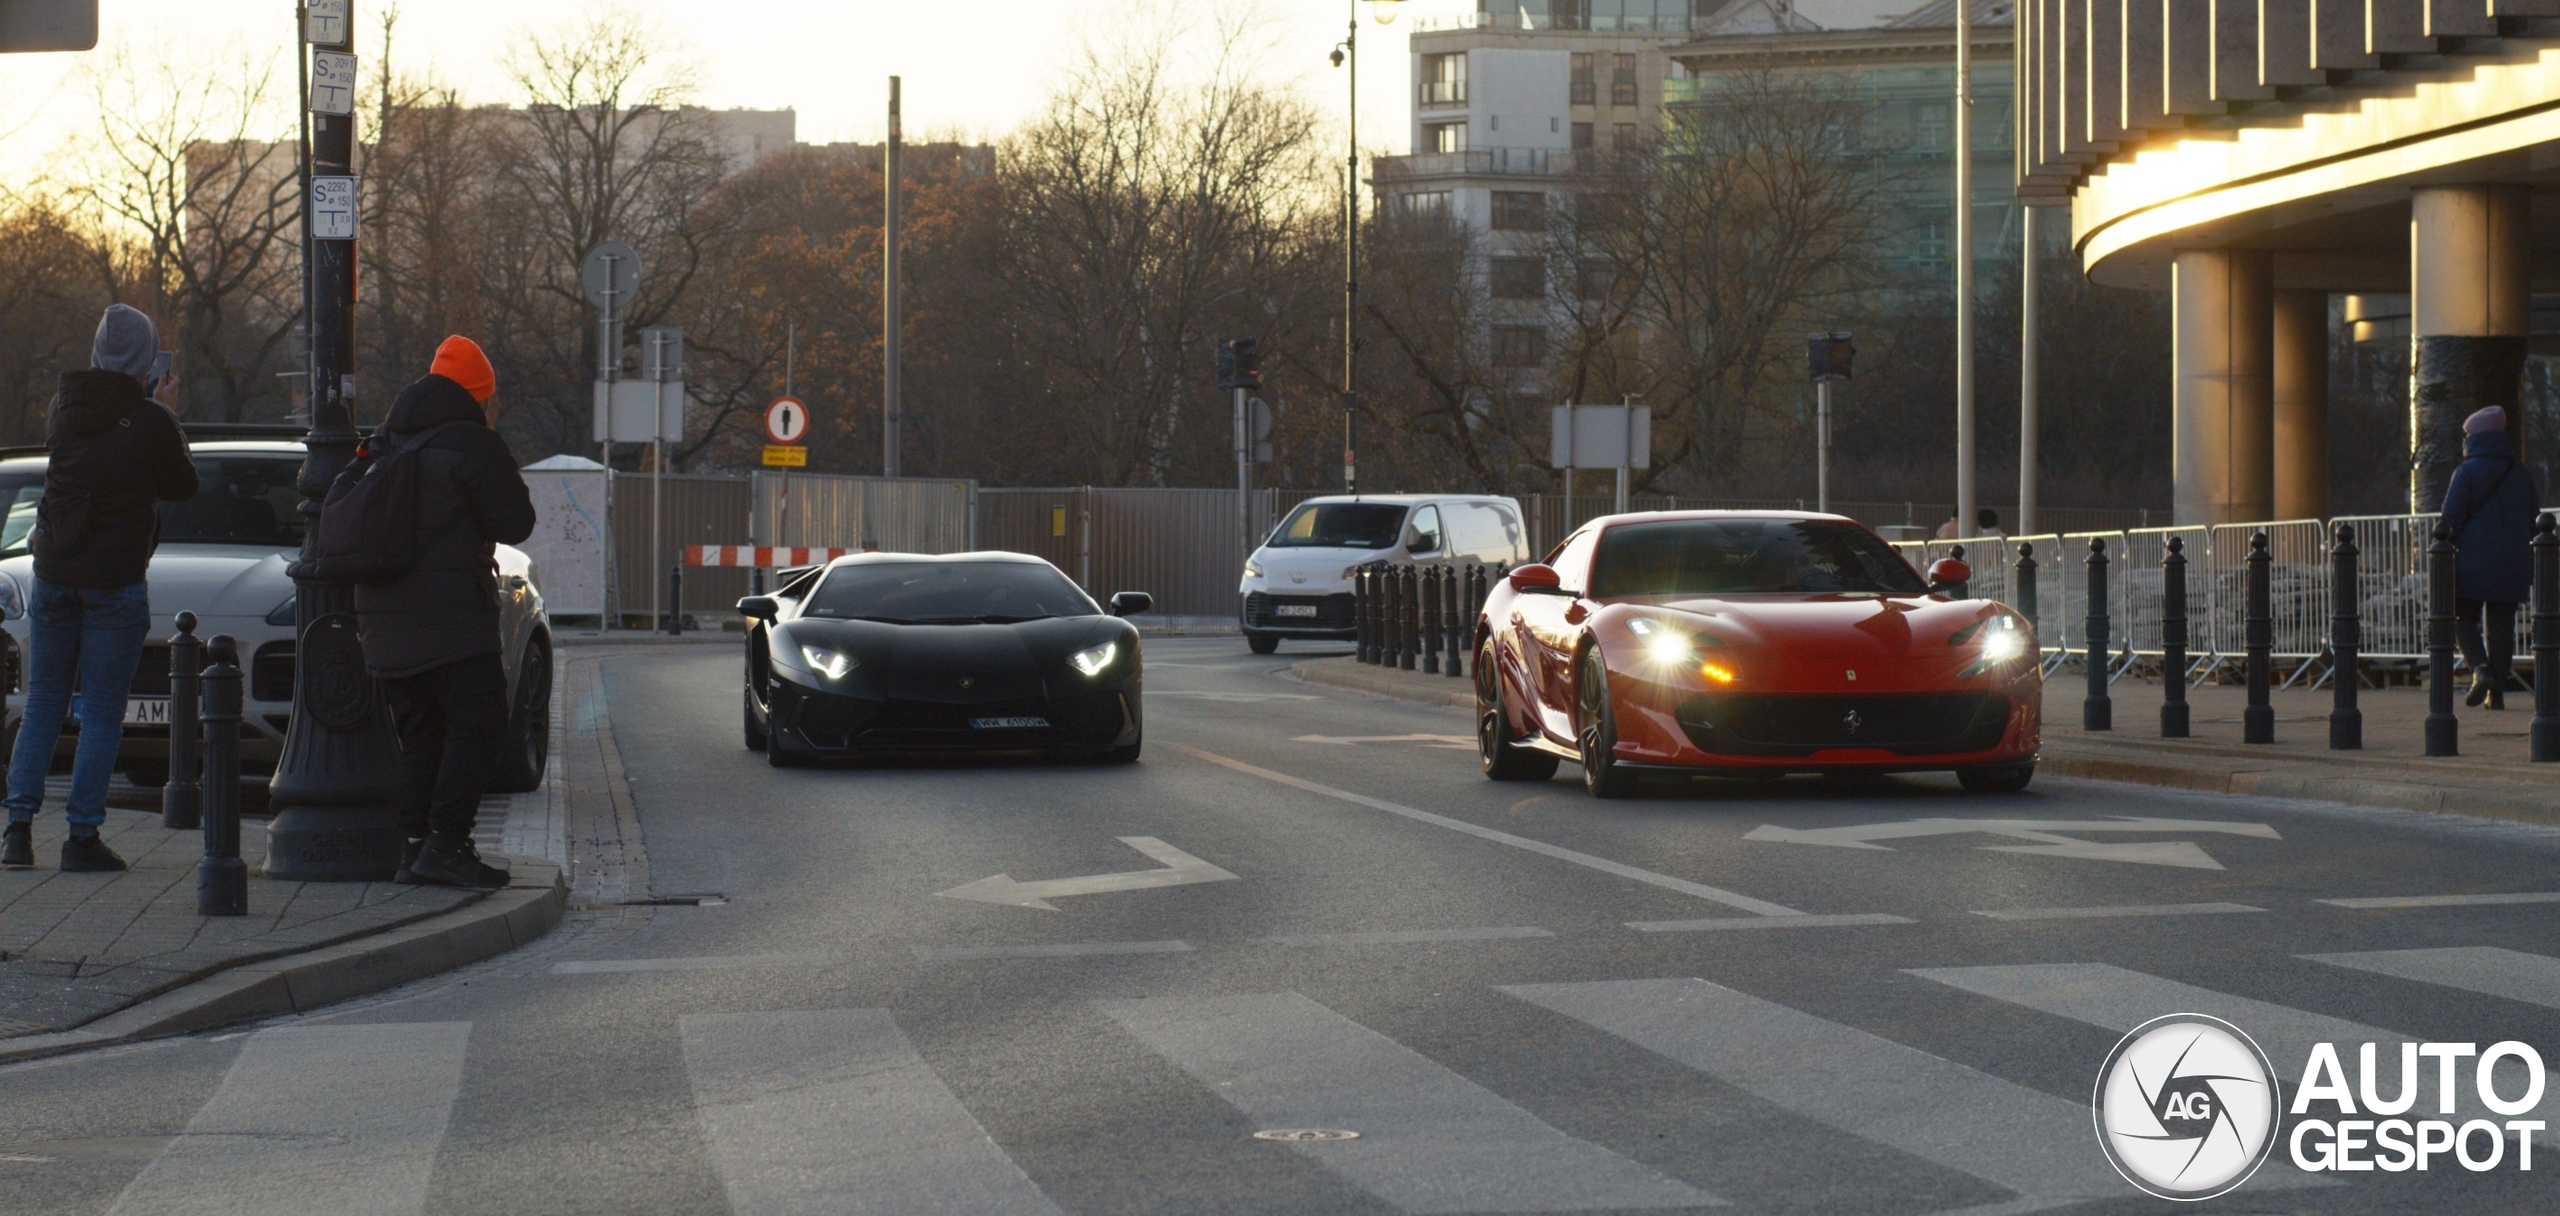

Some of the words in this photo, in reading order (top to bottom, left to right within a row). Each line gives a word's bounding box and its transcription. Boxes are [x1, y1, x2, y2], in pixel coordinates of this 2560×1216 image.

[331, 1, 343, 12] 150
[316, 59, 329, 77] S
[334, 57, 354, 69] 2091
[339, 72, 353, 83] 150
[315, 185, 327, 202] S
[327, 182, 347, 192] 2292
[338, 195, 351, 206] 150
[979, 718, 1000, 726] WW
